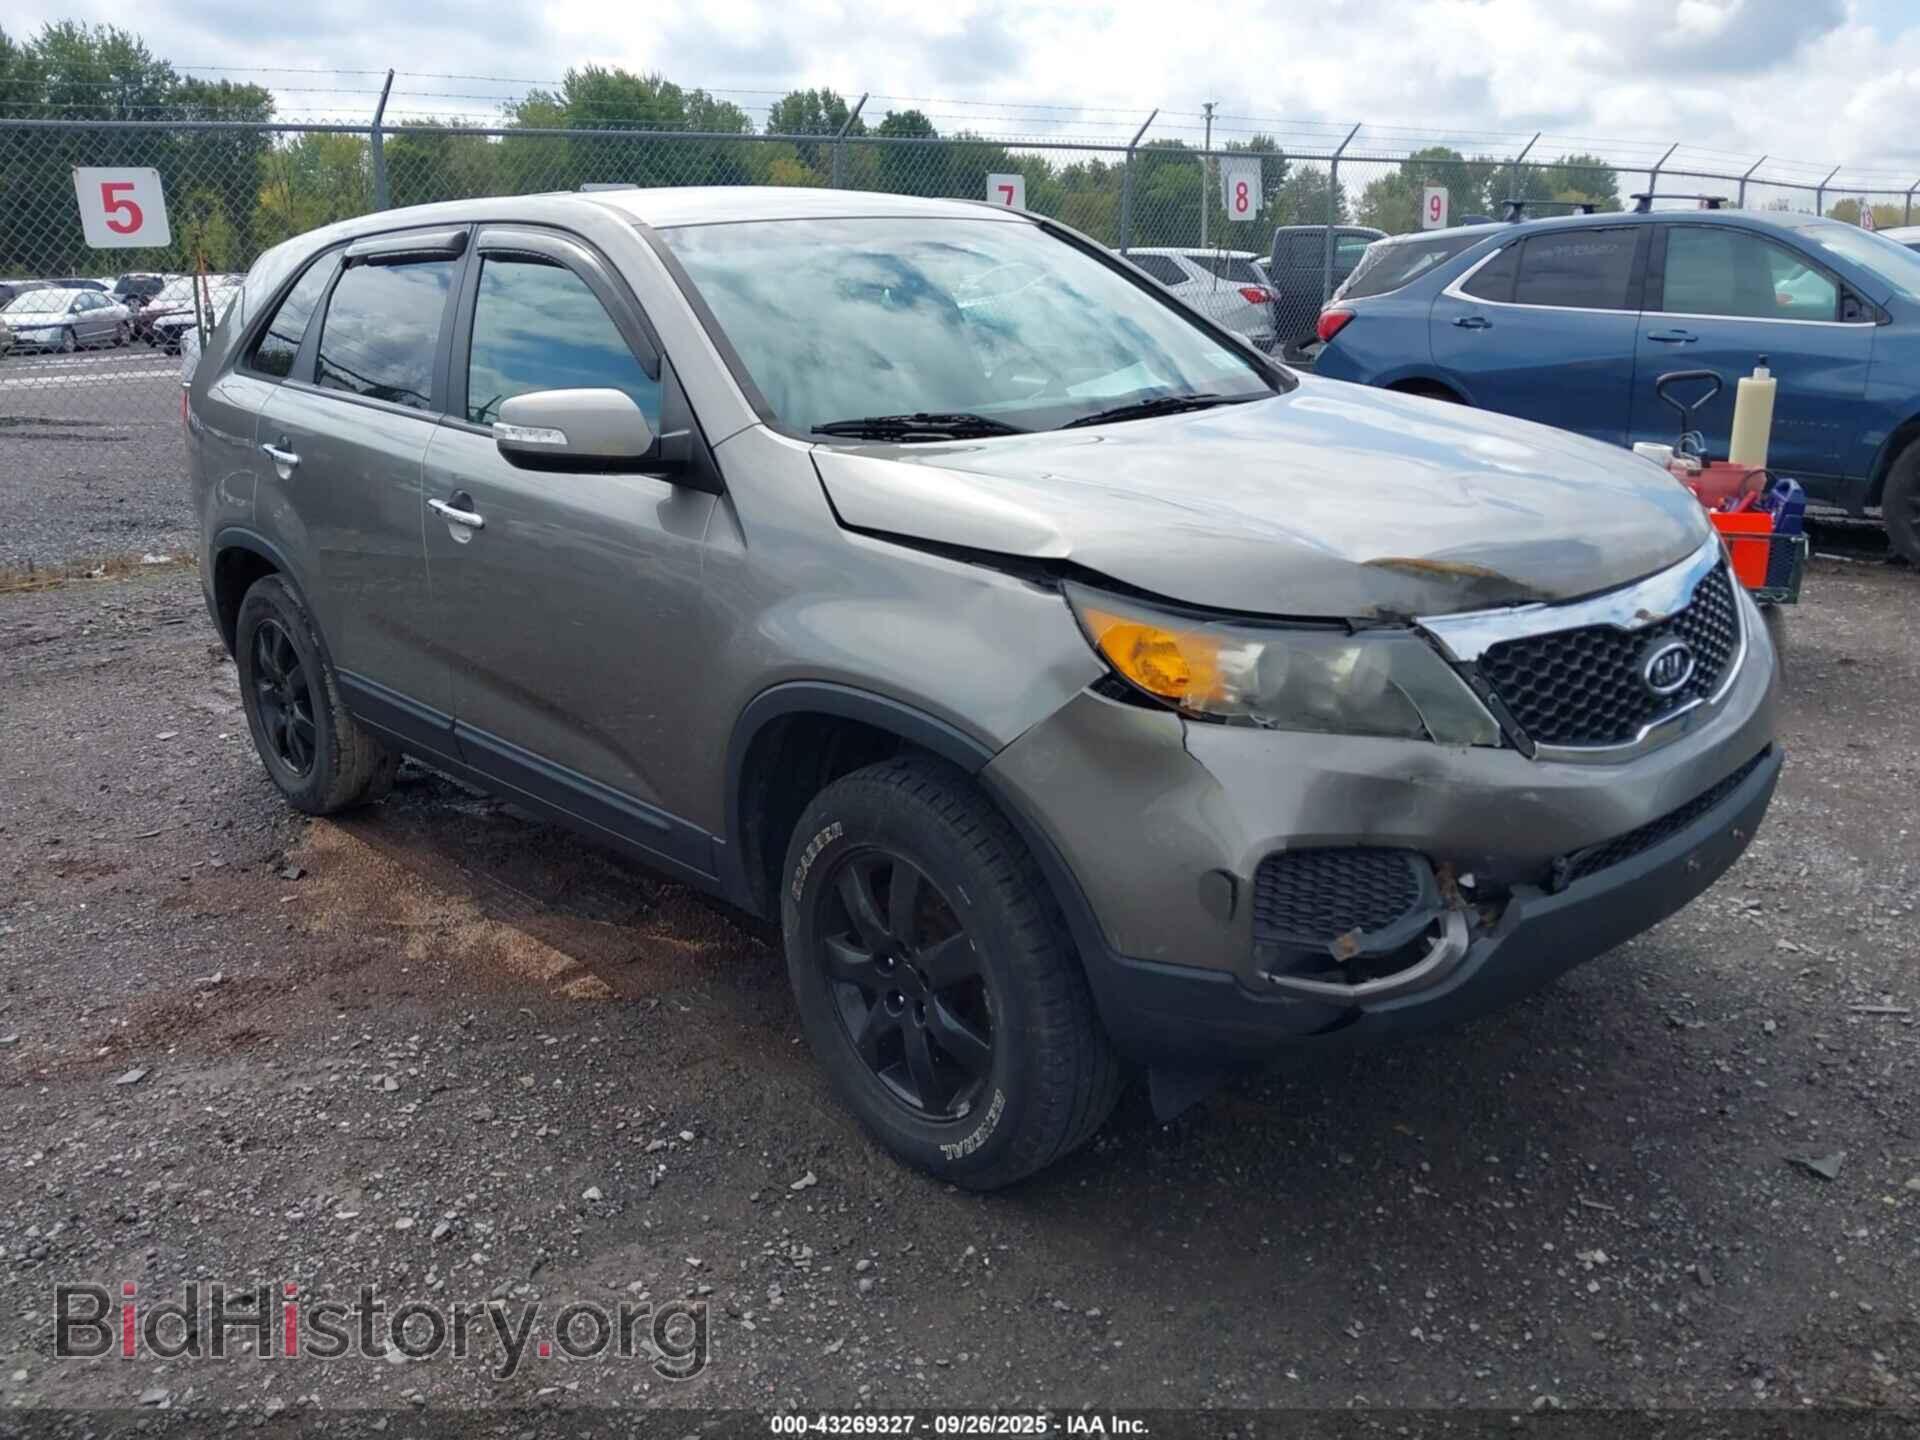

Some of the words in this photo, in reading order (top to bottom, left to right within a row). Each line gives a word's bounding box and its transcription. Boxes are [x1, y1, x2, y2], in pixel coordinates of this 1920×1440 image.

[100, 182, 143, 235] 5
[998, 185, 1014, 206] 7
[1236, 181, 1249, 213] 8
[1430, 195, 1441, 222] 9
[940, 1088, 1006, 1161] GENERAL
